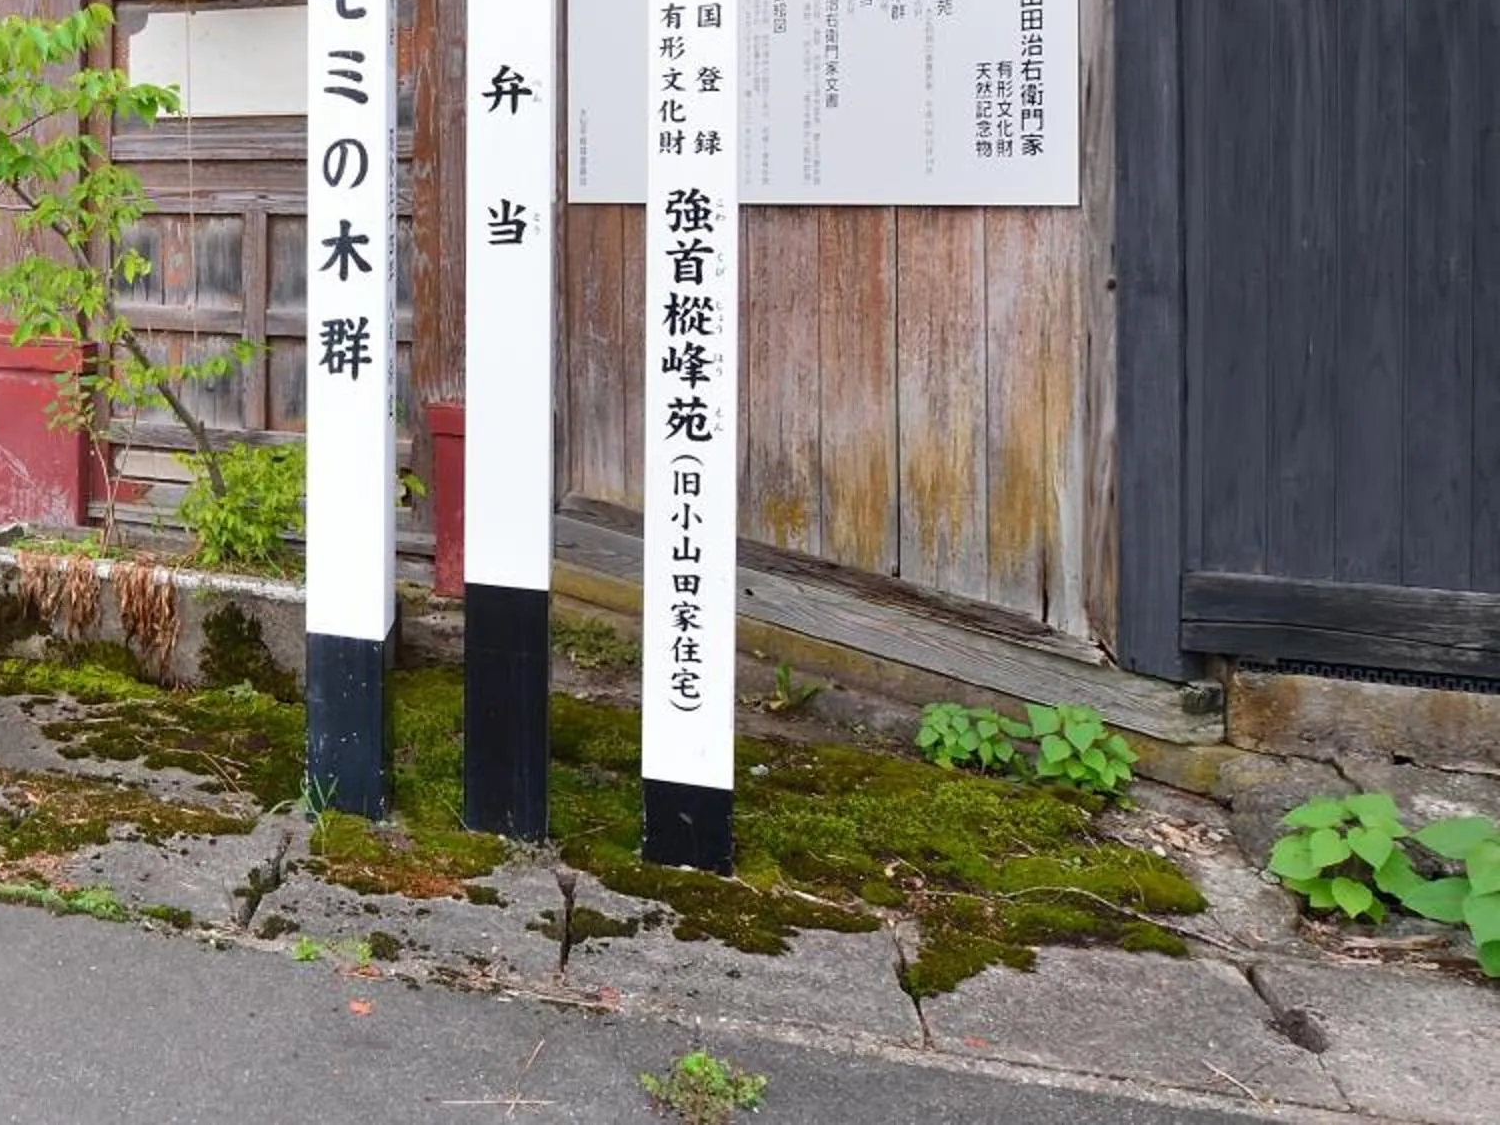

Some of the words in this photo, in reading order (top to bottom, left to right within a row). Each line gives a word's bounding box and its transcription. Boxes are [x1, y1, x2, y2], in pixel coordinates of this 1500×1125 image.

[659, 2, 687, 156] 有形文化財
[693, 2, 724, 156] 国登録
[975, 61, 992, 158] 天然記念物
[997, 60, 1013, 158] 有形文化財
